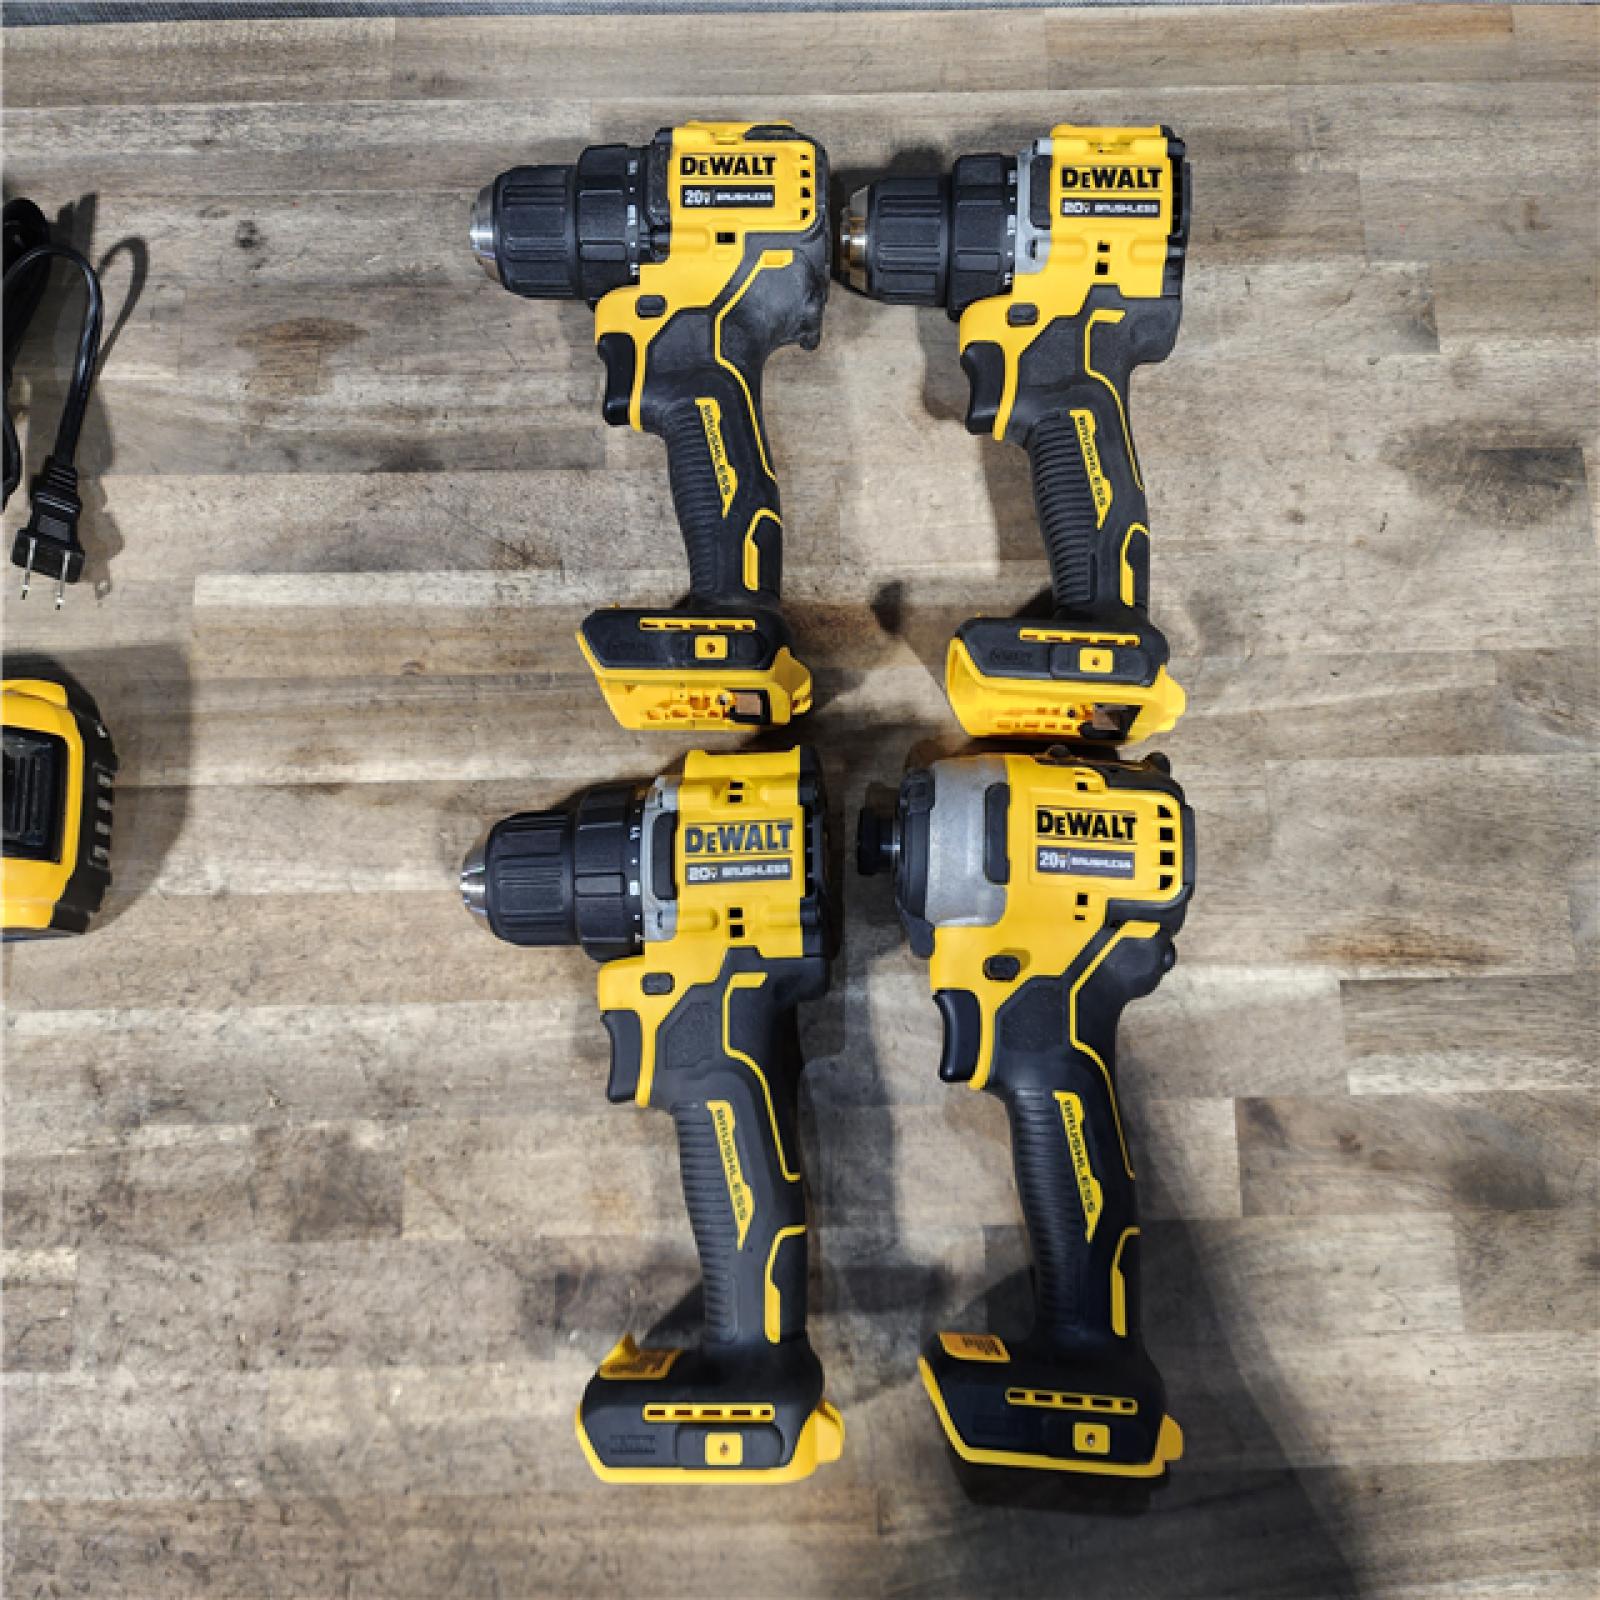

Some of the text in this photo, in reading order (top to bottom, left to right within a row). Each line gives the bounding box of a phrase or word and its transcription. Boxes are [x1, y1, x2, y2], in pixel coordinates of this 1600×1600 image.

[680, 156, 776, 176] DEWALT
[1061, 167, 1163, 189] DEWALT
[684, 823, 793, 853] DEWALT
[1036, 809, 1138, 841] DEWALT
